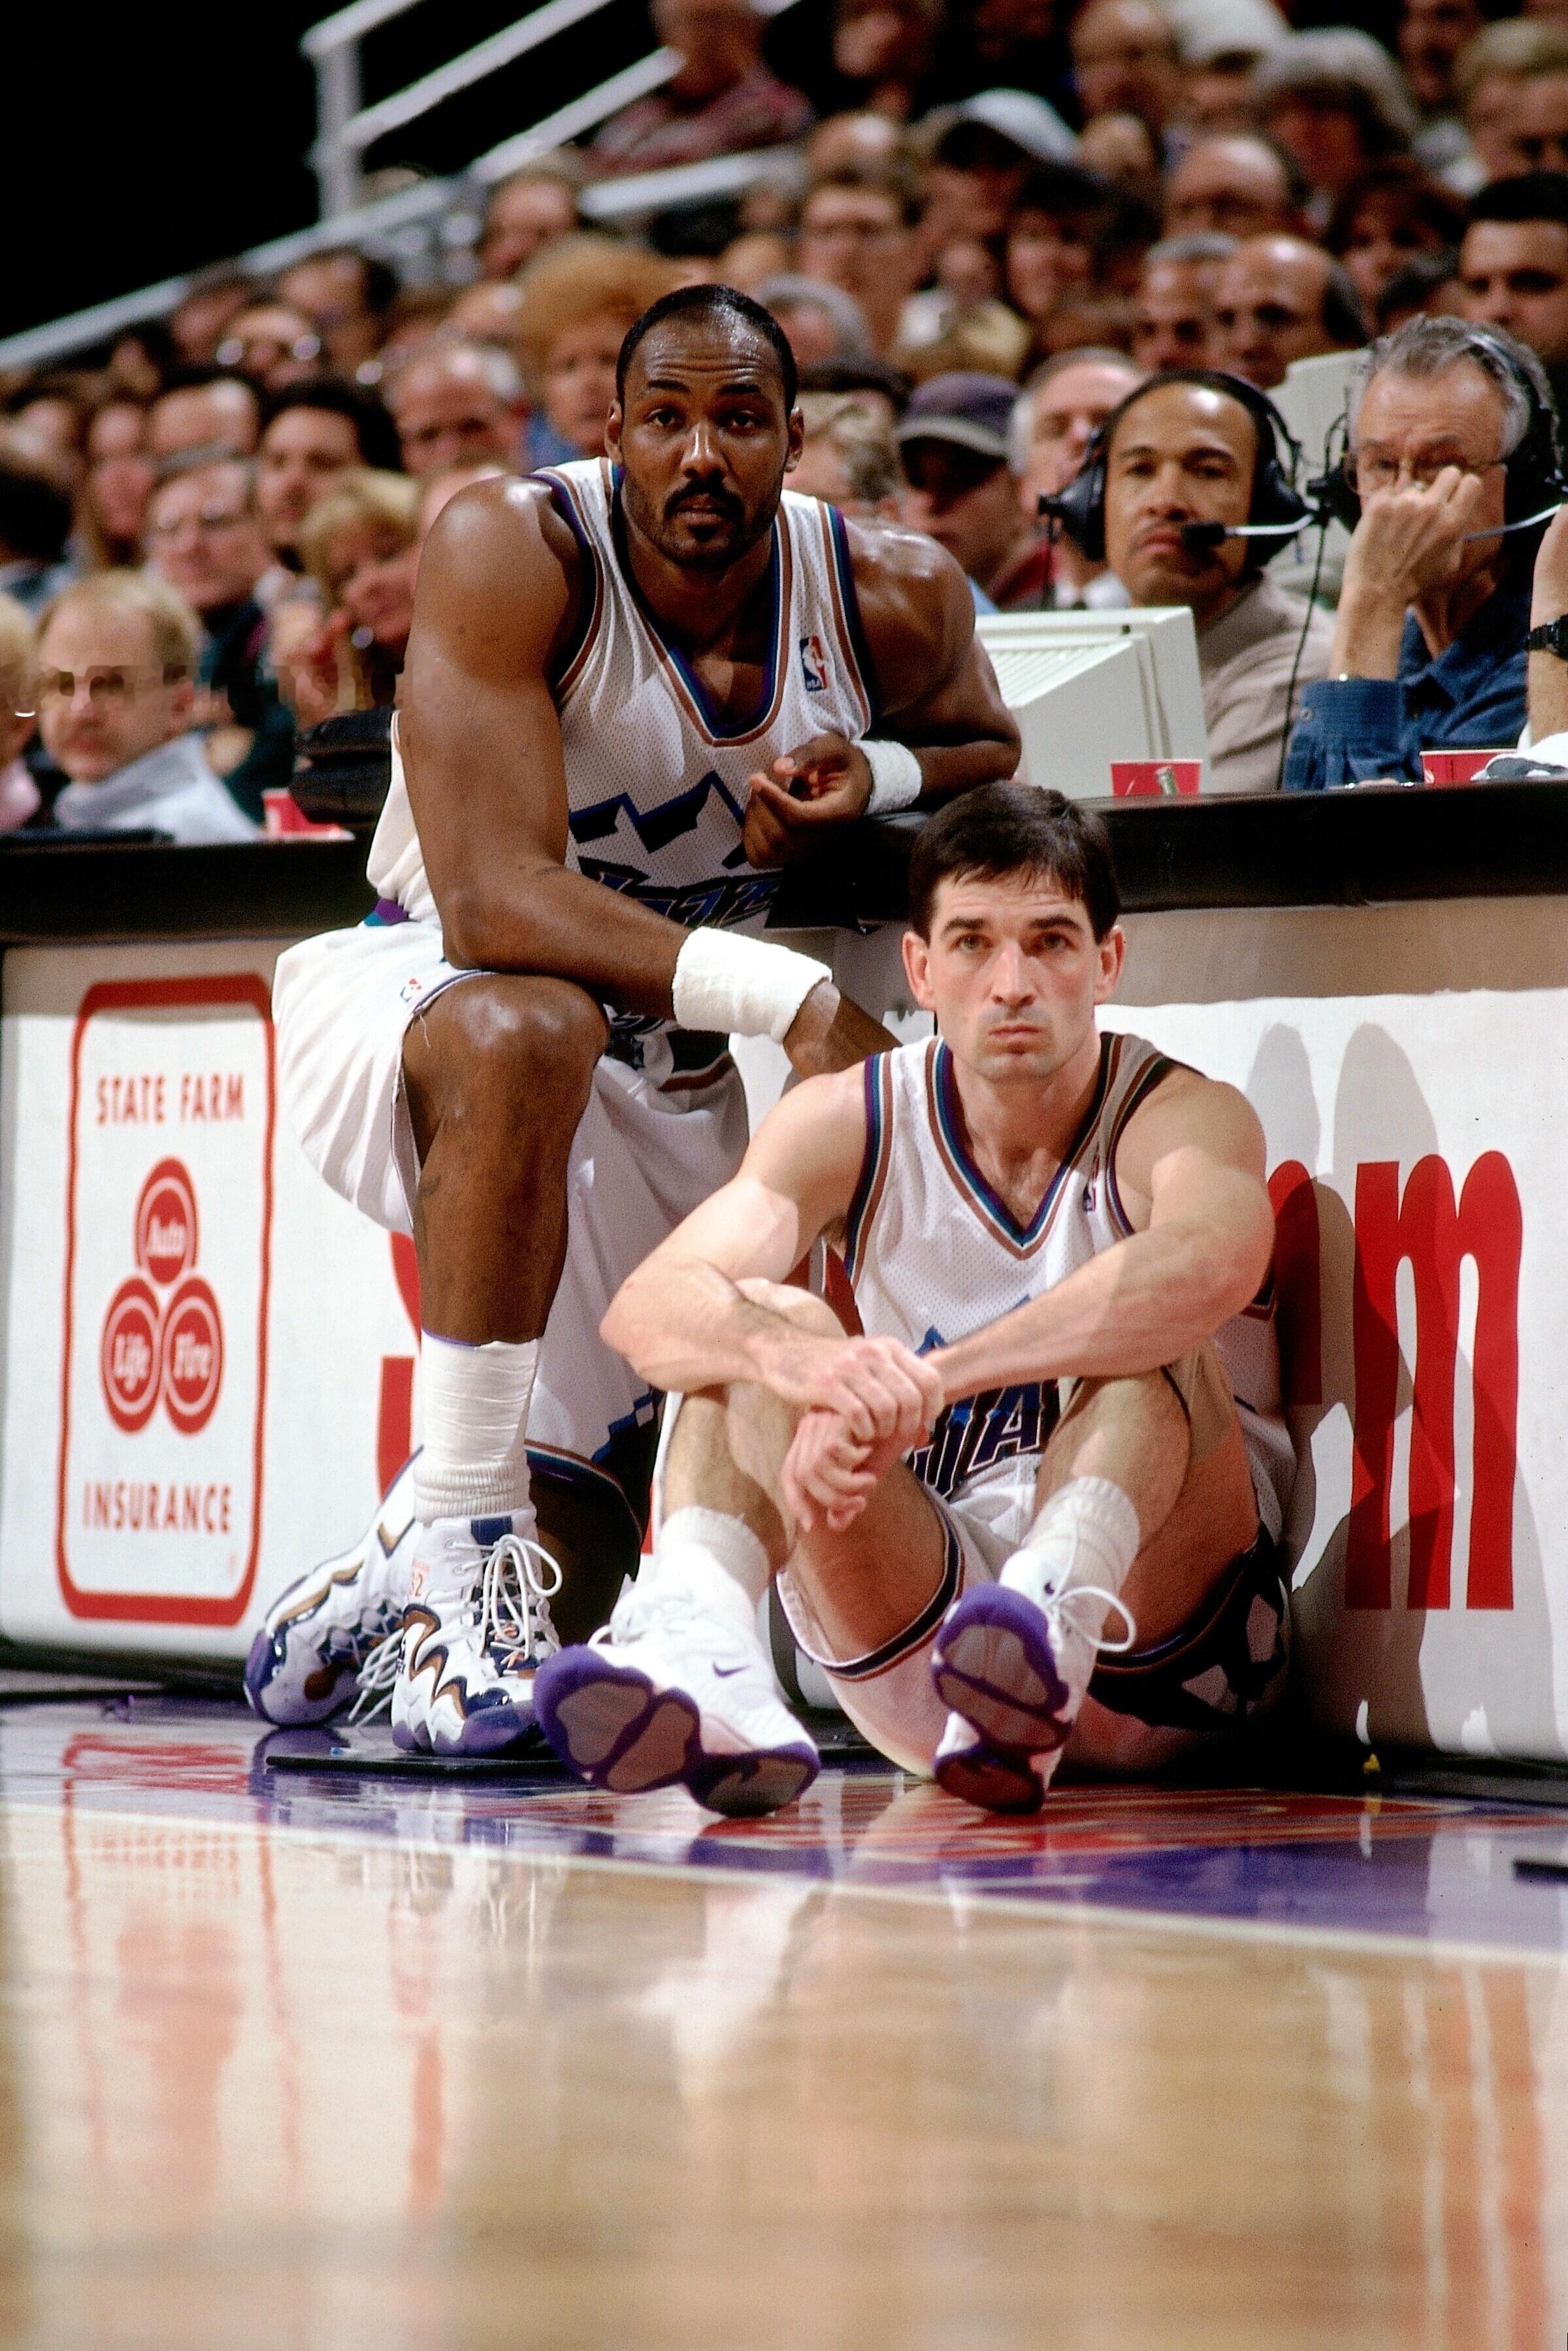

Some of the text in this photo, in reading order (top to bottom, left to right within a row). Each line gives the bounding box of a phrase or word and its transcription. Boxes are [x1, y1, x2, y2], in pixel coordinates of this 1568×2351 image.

[97, 1073, 244, 1125] STATE FARM
[146, 1215, 186, 1257] Auto
[114, 1333, 151, 1392] Life
[174, 1331, 211, 1380] Fire
[913, 1381, 1045, 1499] JA
[84, 1481, 231, 1533] INSURANCE
